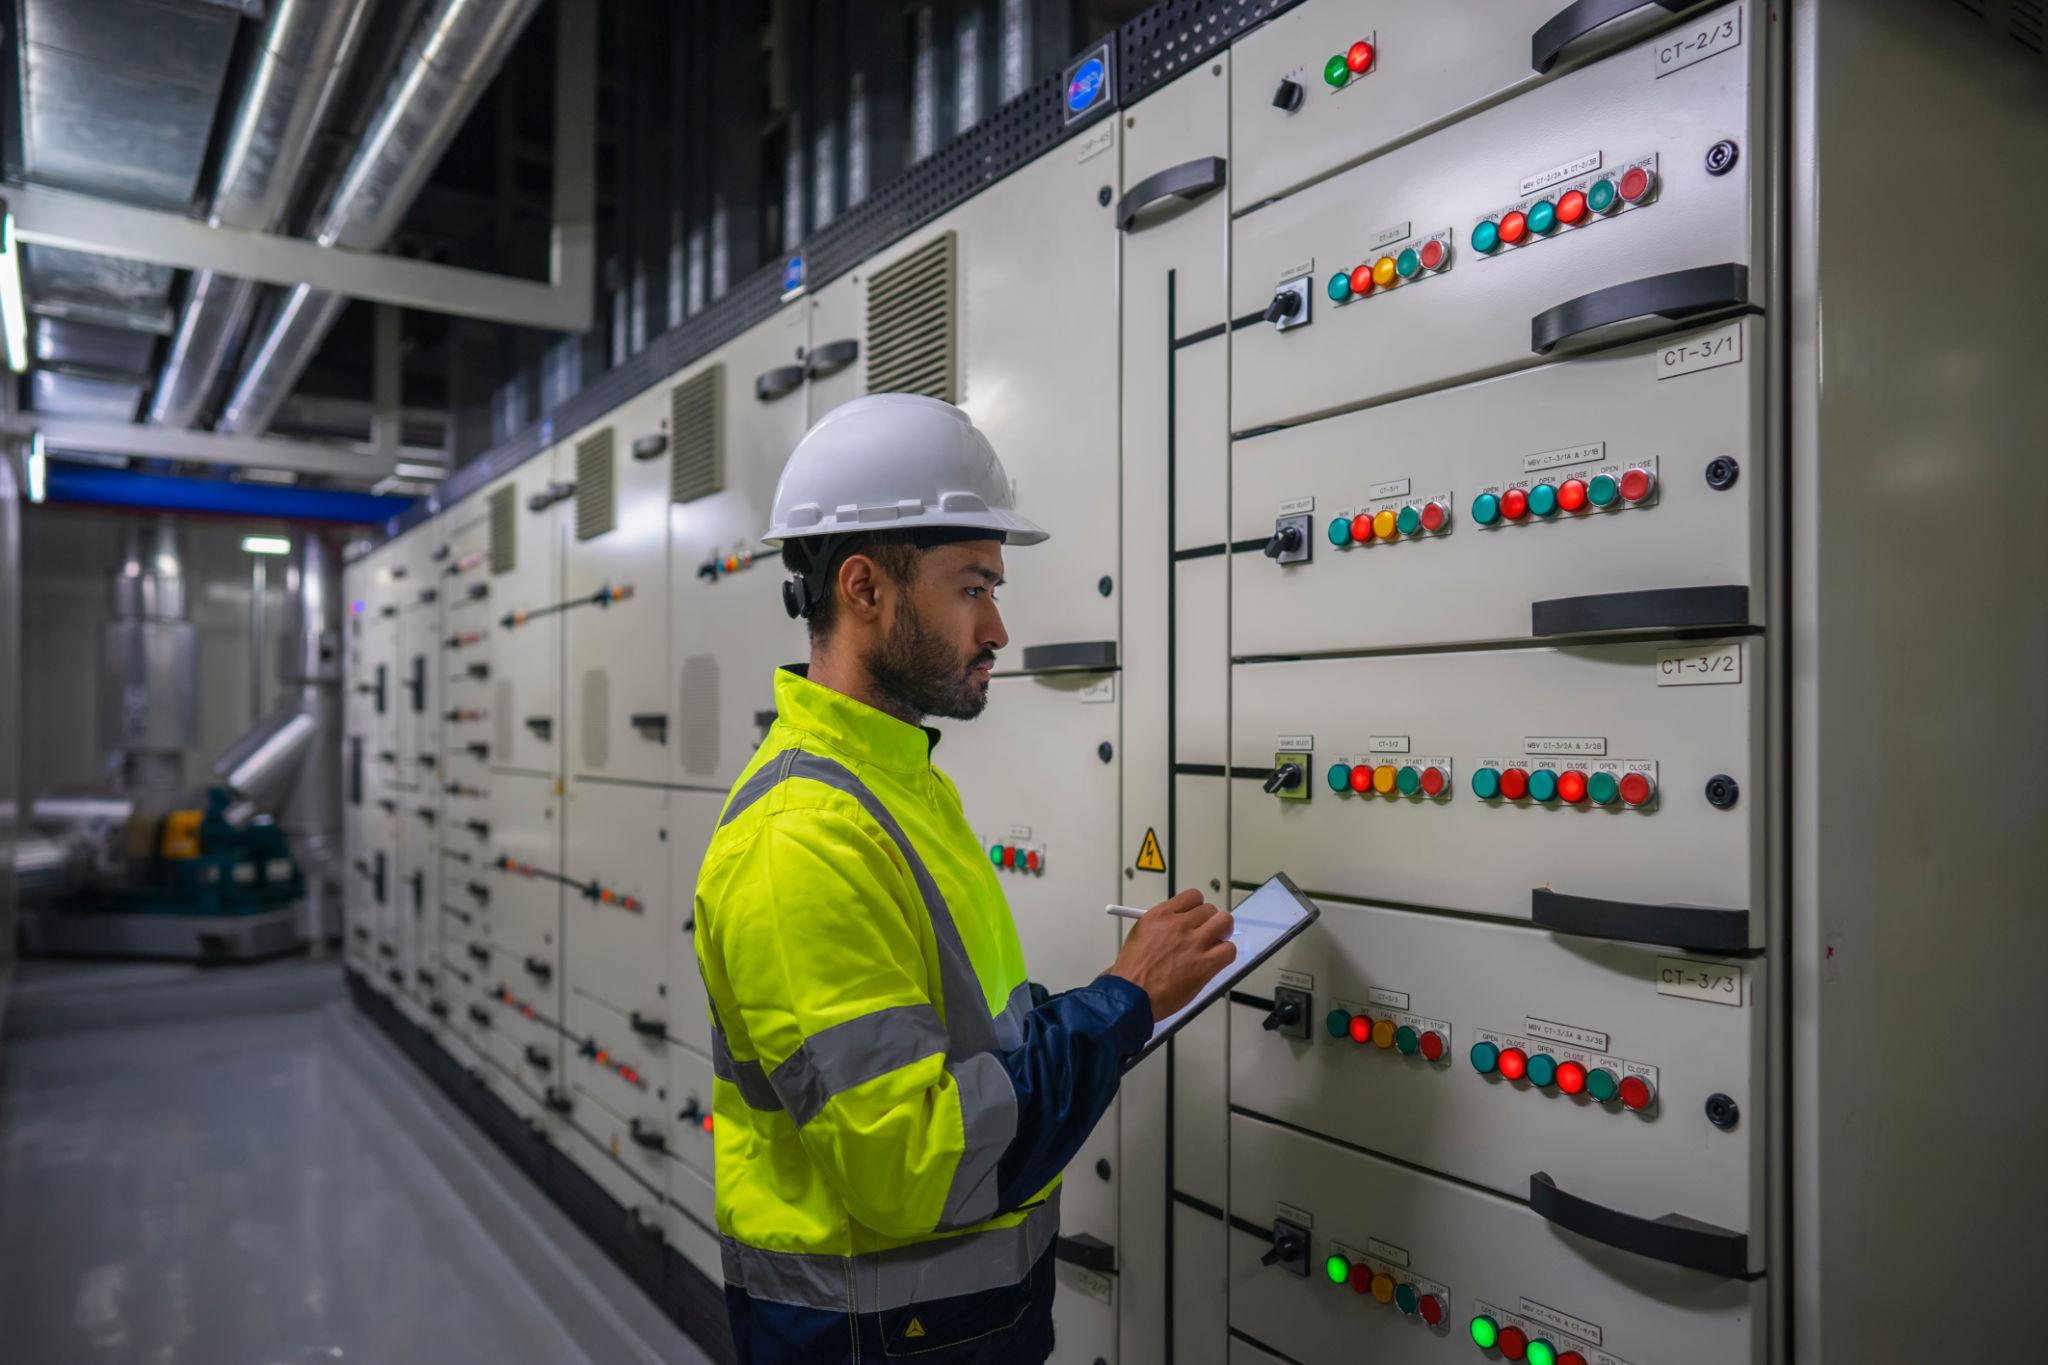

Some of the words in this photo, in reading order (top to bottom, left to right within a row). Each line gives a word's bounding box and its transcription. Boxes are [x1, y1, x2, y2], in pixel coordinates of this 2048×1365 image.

[1661, 21, 1733, 63] CT-2/3
[1664, 336, 1732, 366] CT-3/1
[1543, 453, 1571, 463] CT-3/1A
[1584, 448, 1599, 457] 3/1B
[1601, 465, 1618, 473] OPEN
[1538, 476, 1555, 484] OPEN
[1567, 471, 1587, 480] CLOSE
[1509, 481, 1529, 489] CLOSE
[1662, 656, 1734, 674] CT-3/2
[1629, 763, 1652, 771] CLOSE
[1662, 968, 1734, 993] CT-3/3
[1404, 1017, 1421, 1025] START
[1482, 1033, 1498, 1042] OPEN
[1544, 1026, 1573, 1038] CT-3/3A
[1585, 1035, 1603, 1045] 3/3B
[1506, 1039, 1526, 1048] CLOSE
[1537, 1045, 1554, 1054] OPEN
[1563, 1051, 1584, 1061] CLOSE
[1600, 1058, 1618, 1068] OPEN
[1627, 1065, 1650, 1075] CLOSE
